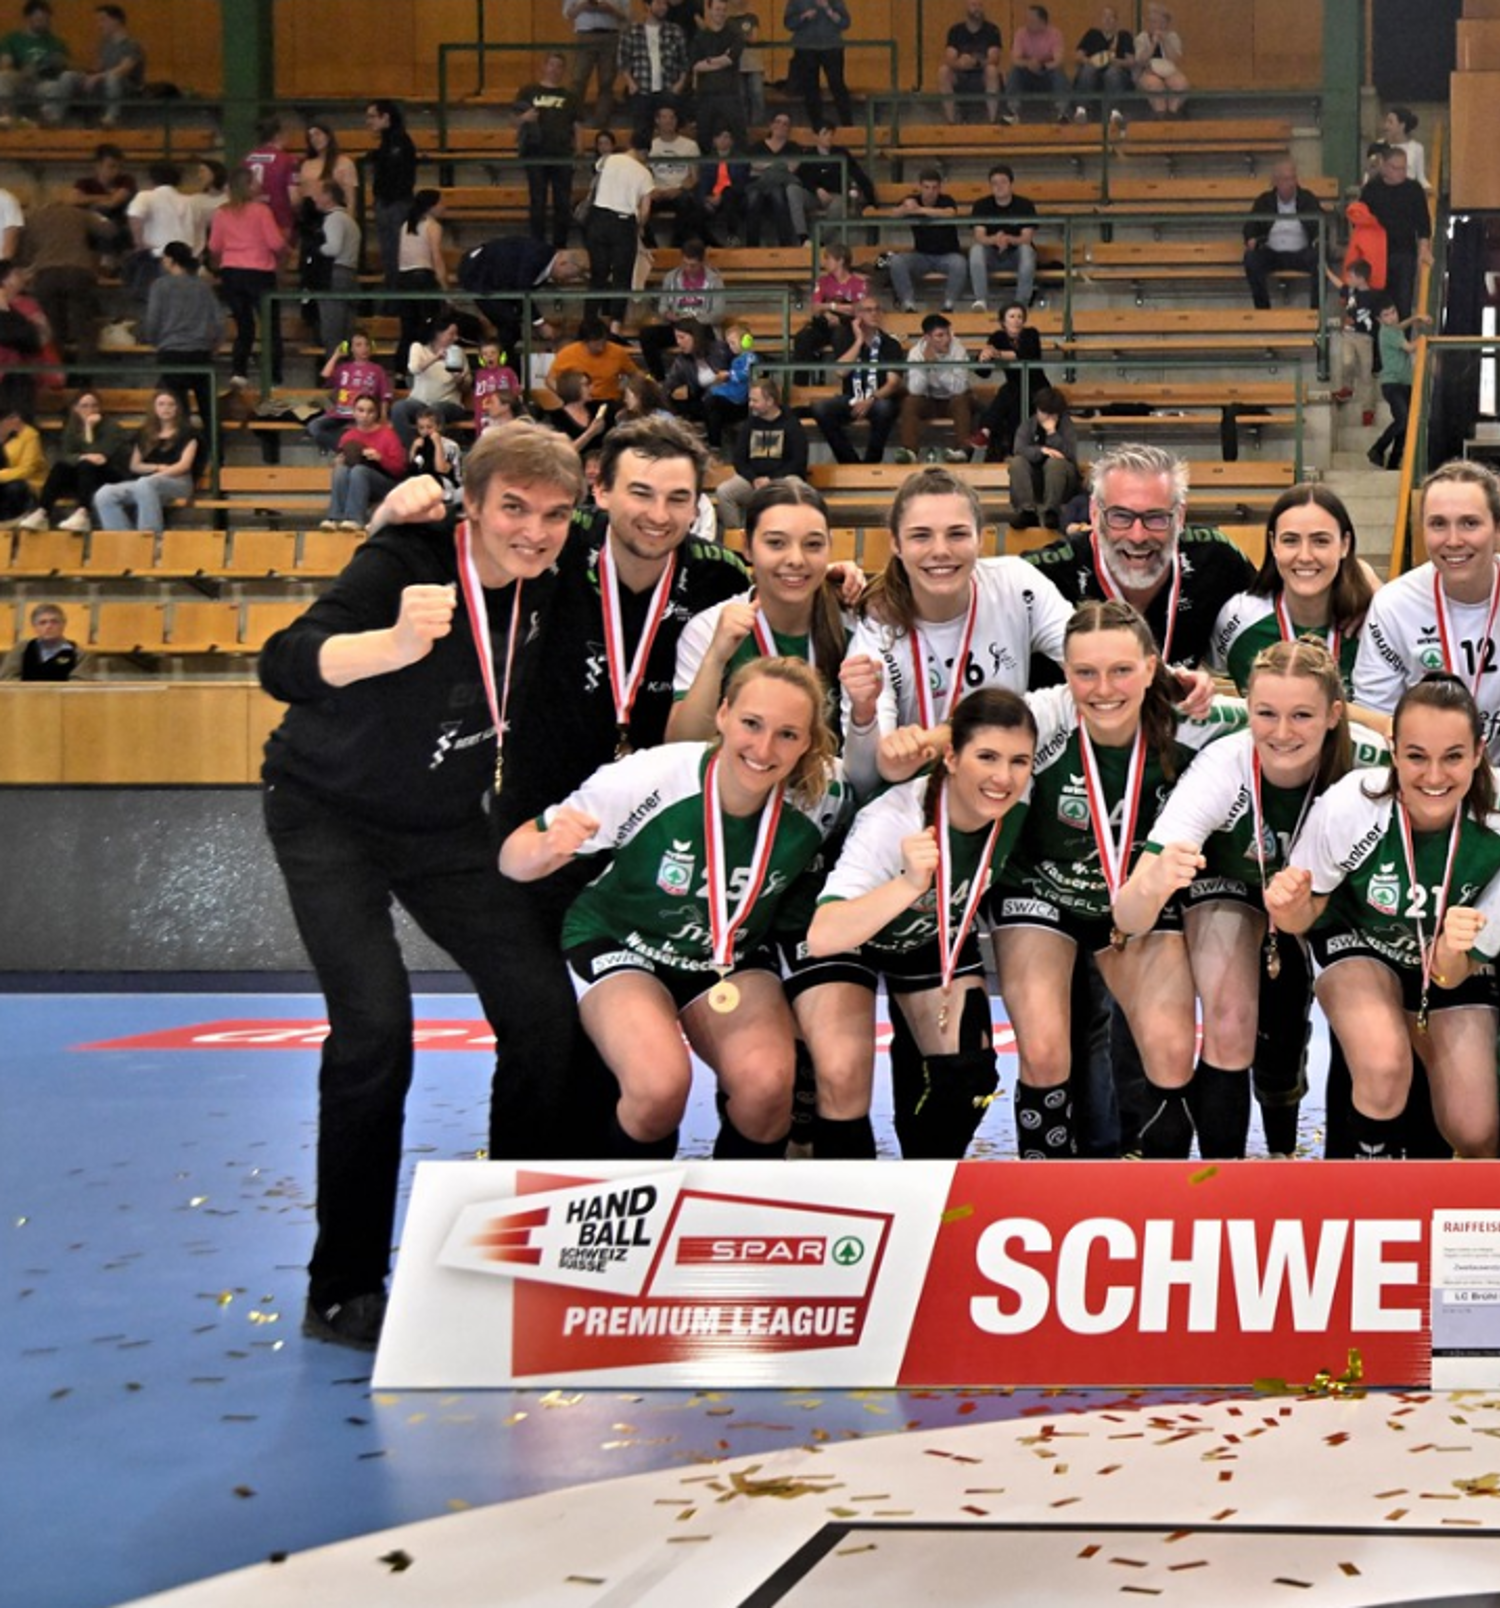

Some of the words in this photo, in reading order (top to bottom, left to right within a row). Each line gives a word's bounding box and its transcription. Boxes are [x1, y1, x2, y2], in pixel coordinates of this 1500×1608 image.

[1460, 637, 1498, 677] 12
[1340, 822, 1383, 871] hntner
[1004, 897, 1058, 921] SWICA
[1404, 884, 1444, 918] 21
[566, 1185, 657, 1224] HAND
[578, 1217, 652, 1247] BALL
[560, 1247, 628, 1262] SCHWEIZ
[711, 1240, 824, 1262] SPAR
[558, 1259, 607, 1274] SUISSE
[970, 1217, 1422, 1335] SCHWE
[1455, 1292, 1468, 1301] LC
[562, 1306, 719, 1337] PREMIUM
[730, 1306, 856, 1336] LEAGUE
